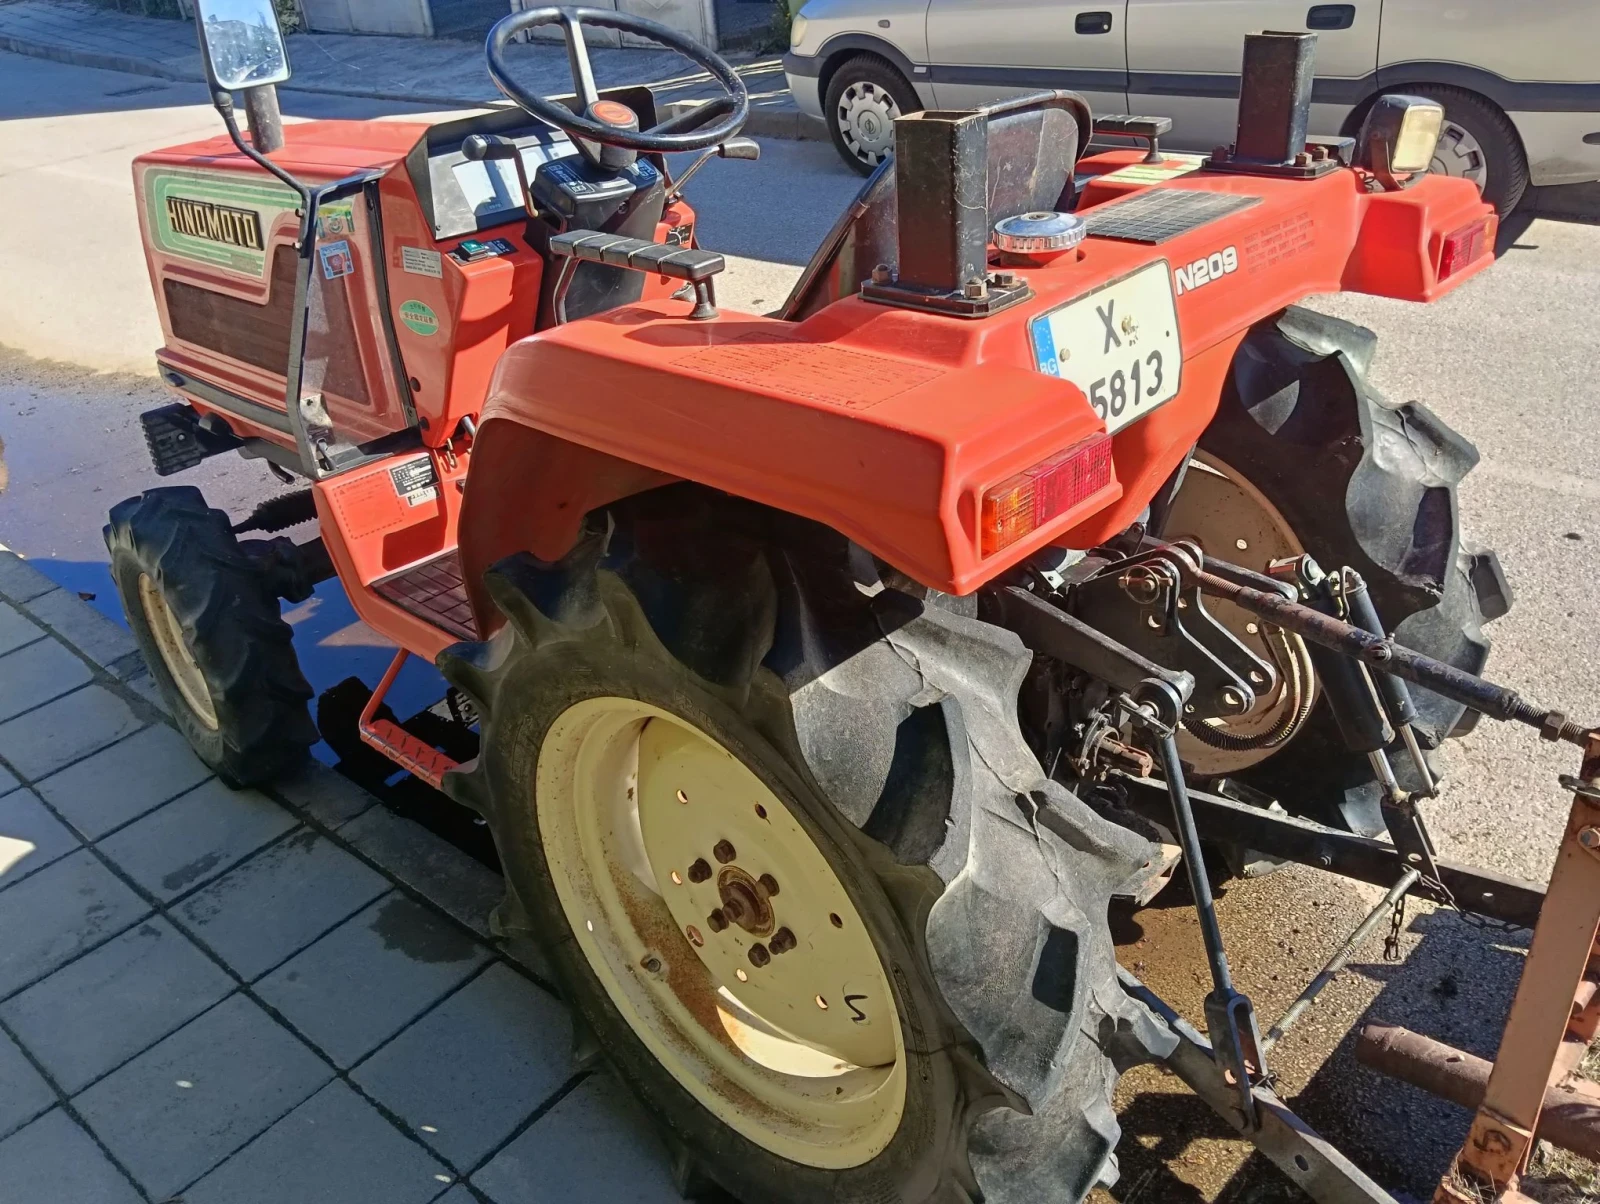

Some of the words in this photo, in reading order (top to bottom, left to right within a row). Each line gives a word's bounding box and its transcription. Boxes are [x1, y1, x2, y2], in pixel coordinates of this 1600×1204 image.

[166, 197, 262, 249] HINOMOTO
[1174, 245, 1239, 296] N209
[1095, 298, 1123, 355] X
[1040, 358, 1058, 374] BG
[1081, 350, 1164, 420] 5813
